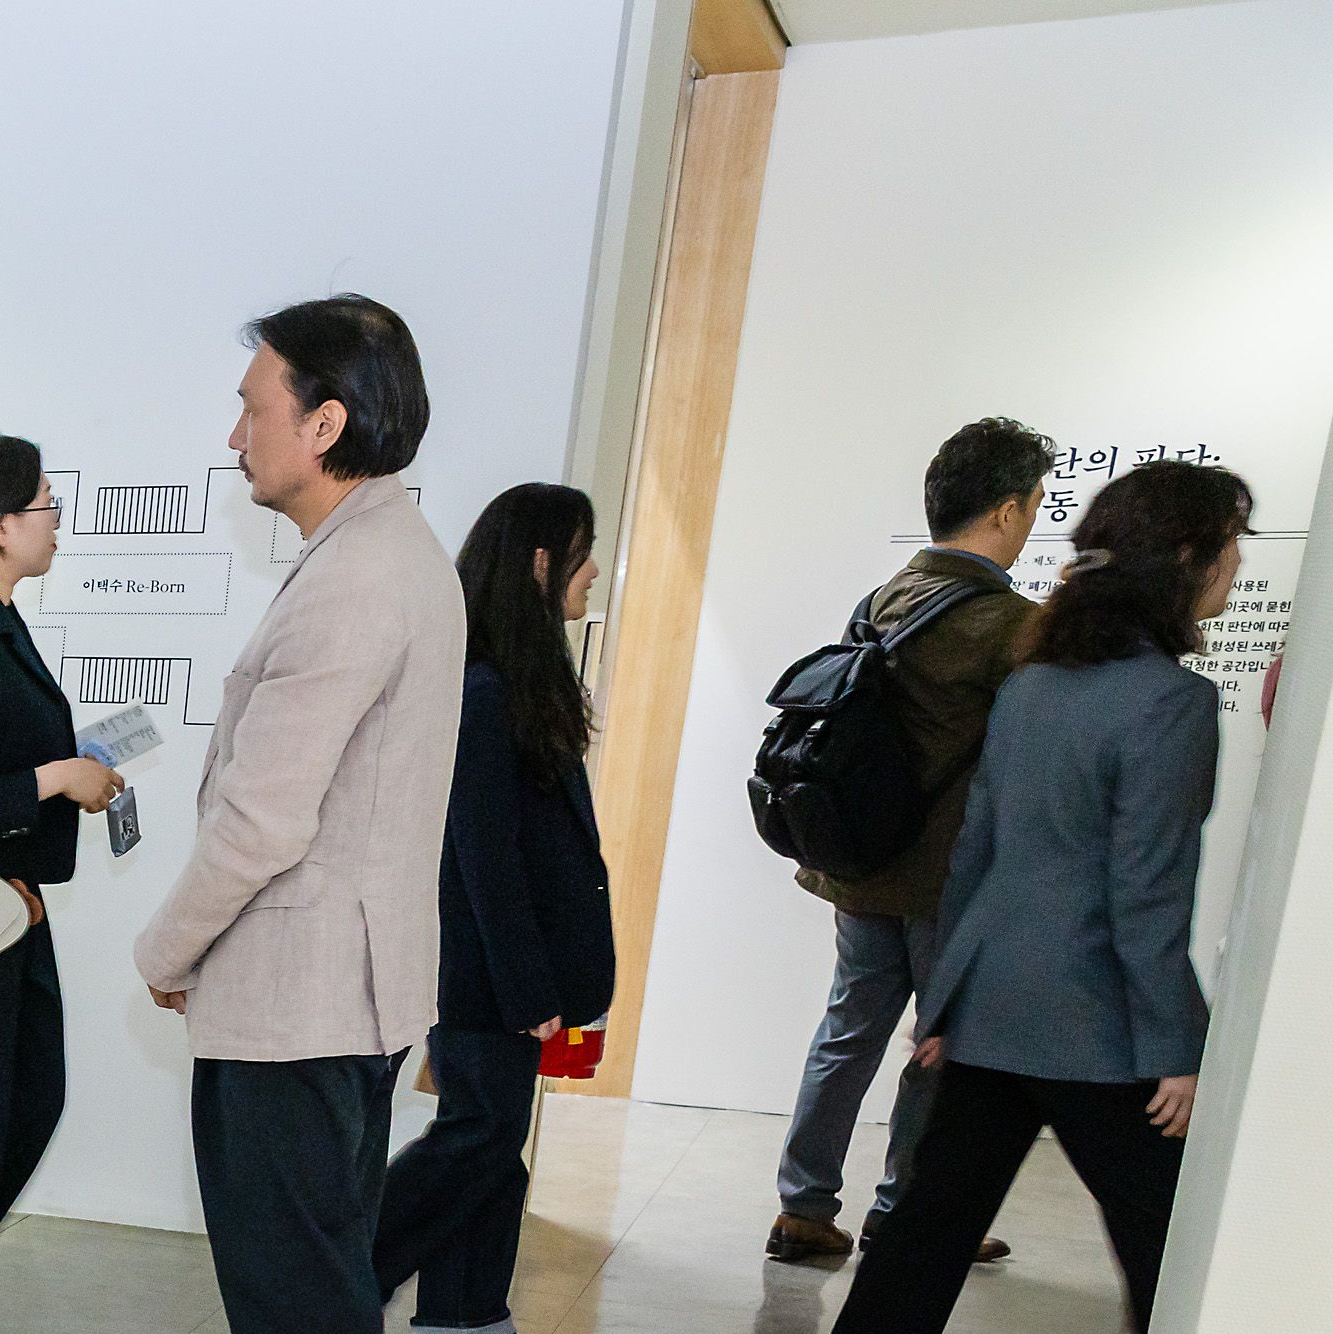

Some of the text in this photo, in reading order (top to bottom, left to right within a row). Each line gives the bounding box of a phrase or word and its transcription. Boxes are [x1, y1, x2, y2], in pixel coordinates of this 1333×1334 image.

[83, 579, 185, 593] 이택수 Re-Born
[1200, 621, 1225, 632] 회적
[1227, 621, 1266, 633] 판단에
[1211, 641, 1249, 653] 형성된
